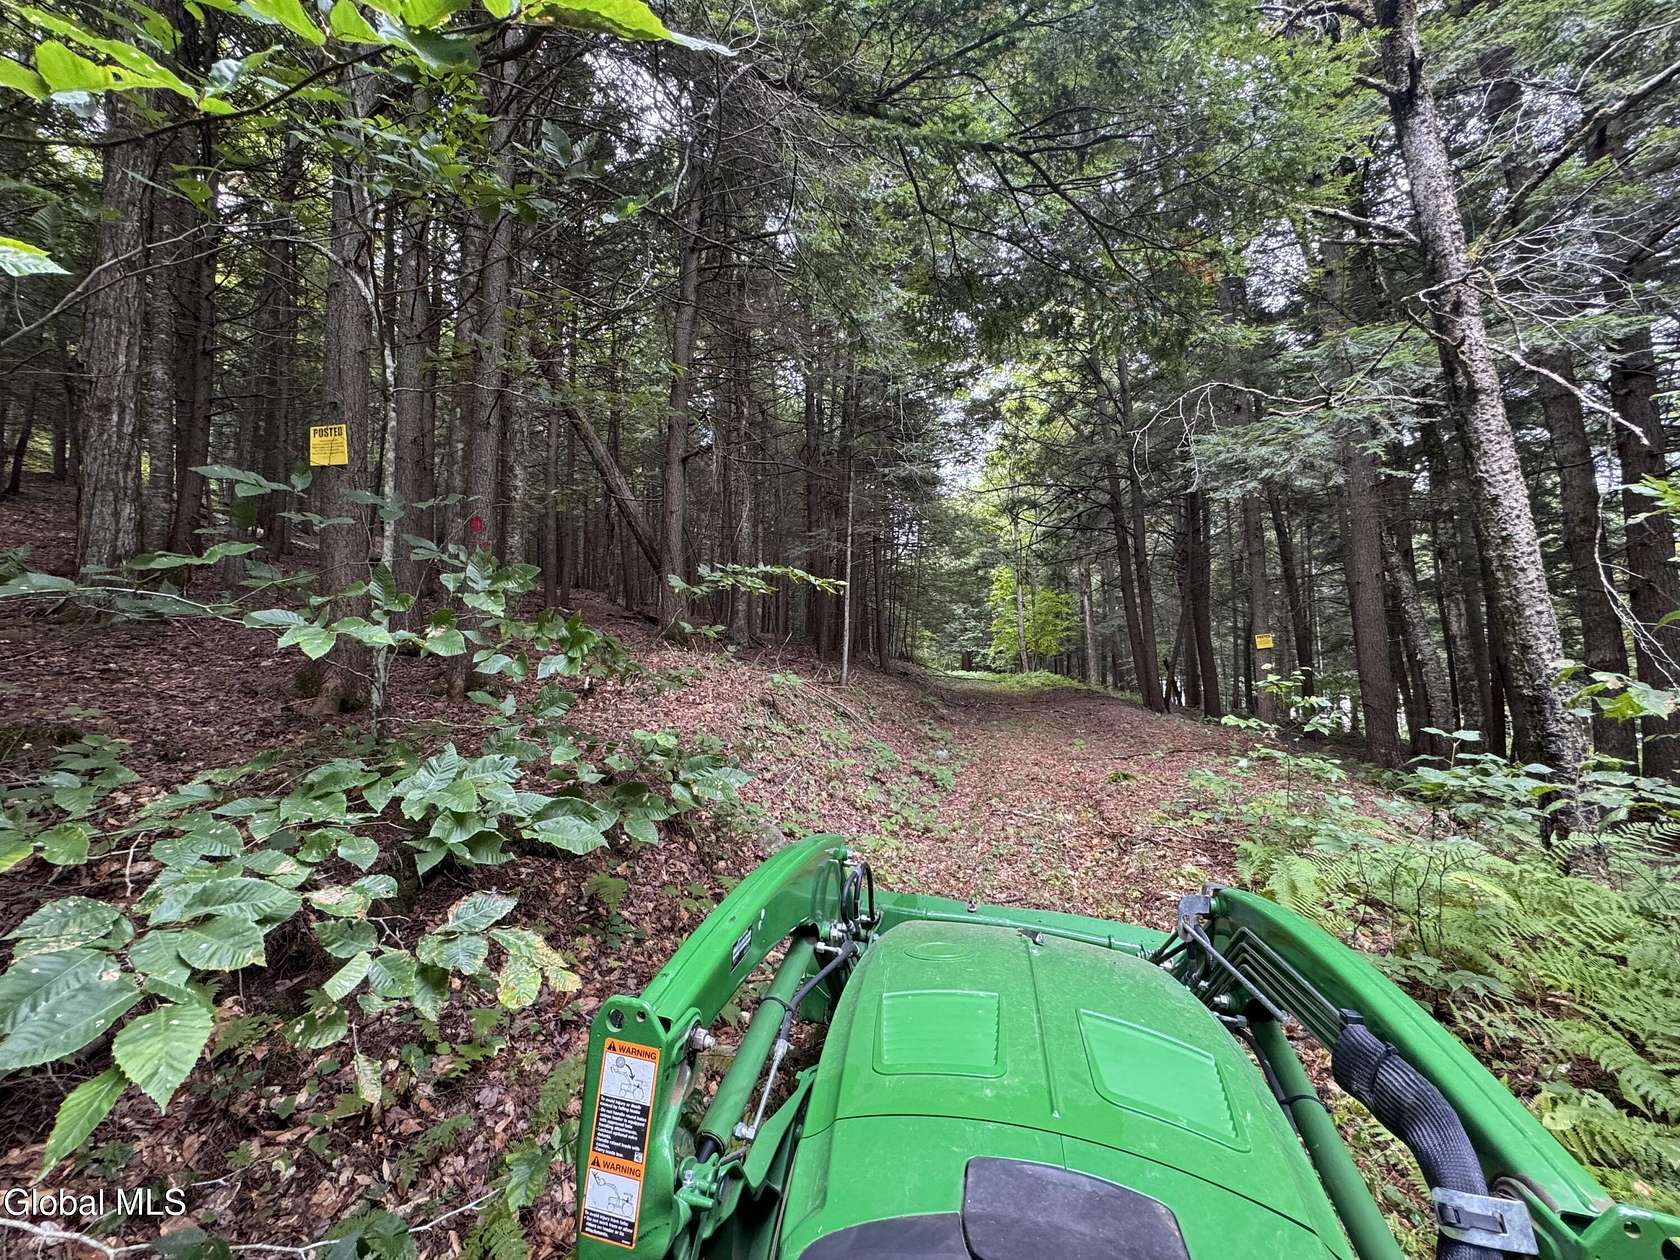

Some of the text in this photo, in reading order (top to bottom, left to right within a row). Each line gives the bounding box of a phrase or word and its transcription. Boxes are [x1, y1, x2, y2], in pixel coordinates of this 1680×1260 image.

[313, 427, 342, 438] POSTED
[618, 1045, 656, 1060] WARNING
[603, 1160, 640, 1177] WARNING
